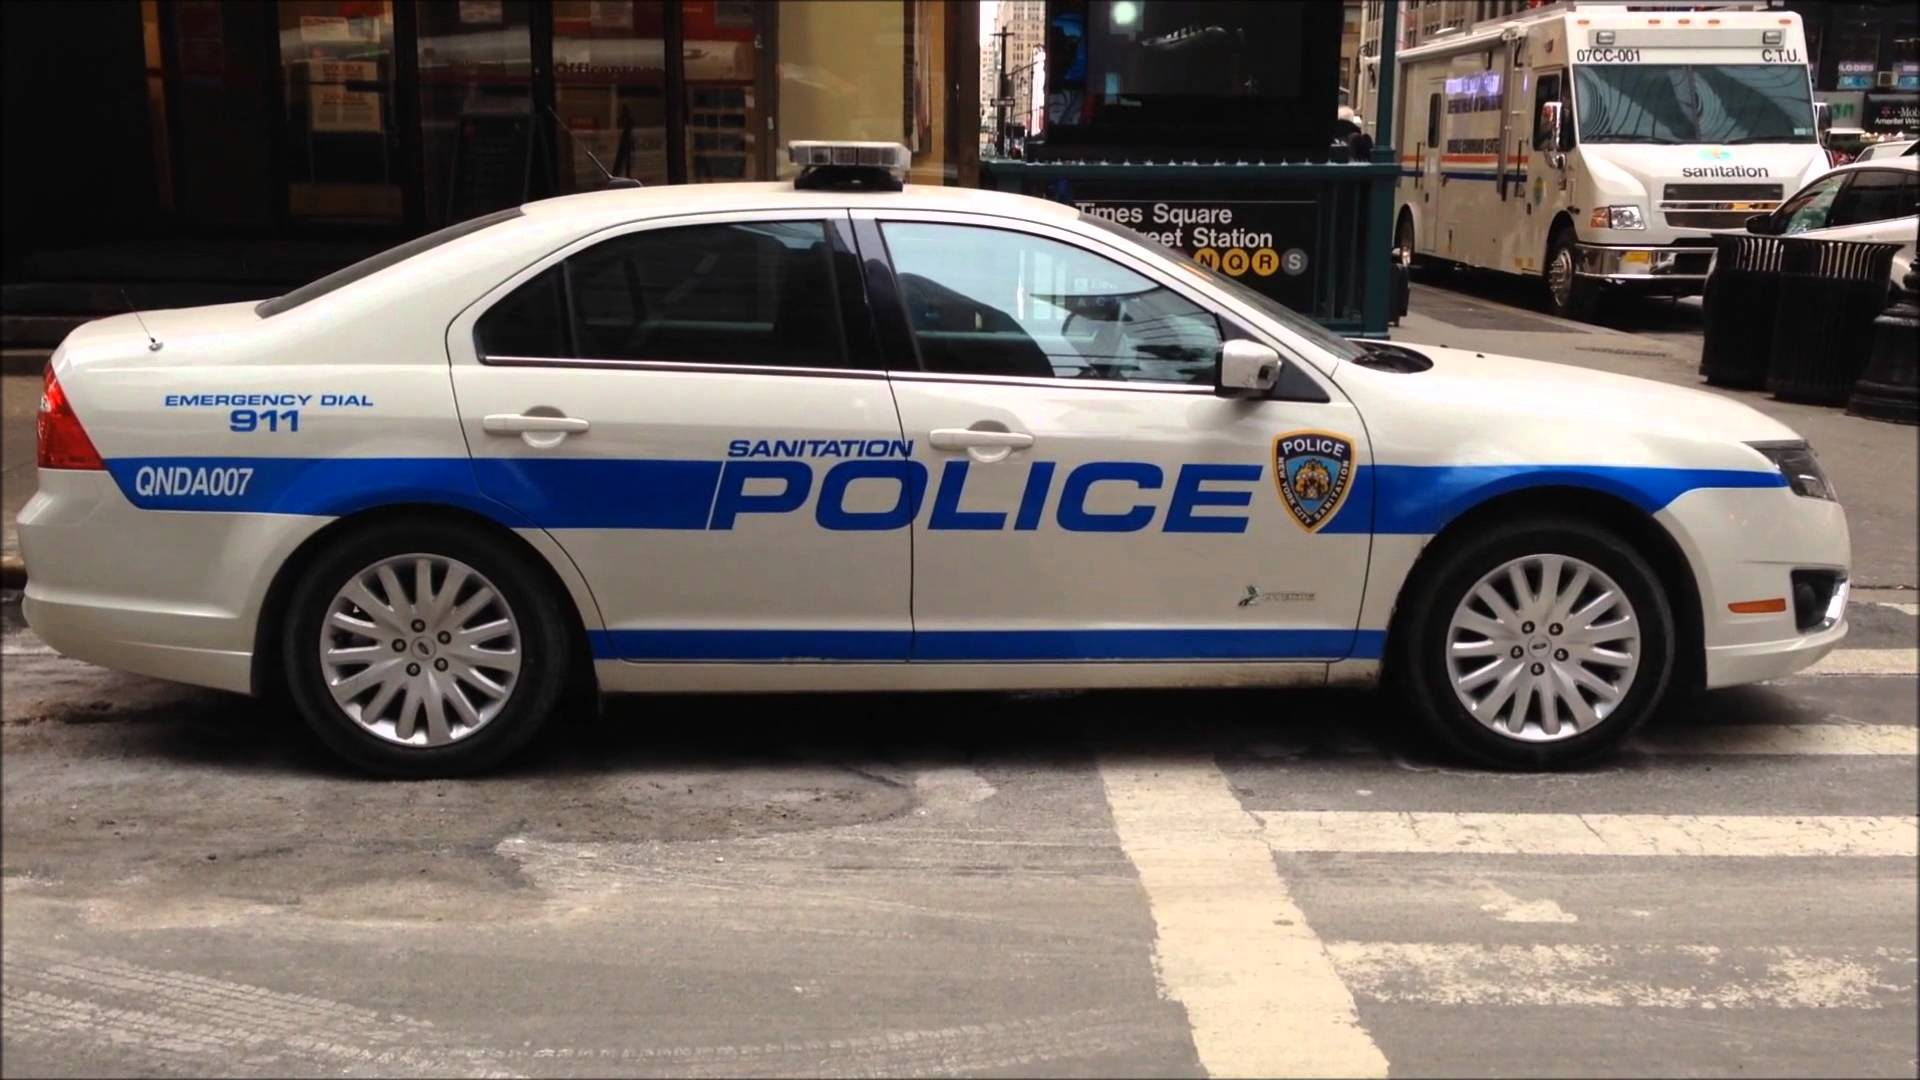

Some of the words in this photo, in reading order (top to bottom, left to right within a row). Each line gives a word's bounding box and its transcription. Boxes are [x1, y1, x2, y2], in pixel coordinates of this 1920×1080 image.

[1576, 49, 1641, 62] 07CC-001
[1762, 50, 1801, 62] C.T.U.
[1682, 166, 1769, 178] sanitation
[1076, 203, 1143, 224] Times
[1153, 203, 1233, 227] Square
[1193, 227, 1272, 248] Station
[1200, 254, 1213, 270] N
[1228, 254, 1243, 271] Q
[1258, 254, 1273, 270] R
[1288, 254, 1302, 270] S
[165, 394, 312, 406] EMERGENCY
[320, 394, 373, 406] DIAL
[229, 410, 299, 432] 911
[728, 440, 914, 457] SANITATION
[1282, 438, 1345, 457] POLICE
[135, 466, 253, 496] QNDA007
[1278, 457, 1286, 479] NEW
[1282, 481, 1297, 507] YORK
[1294, 506, 1312, 524] CITY
[1314, 460, 1350, 520] SANITATION
[708, 460, 1264, 532] POLICE
